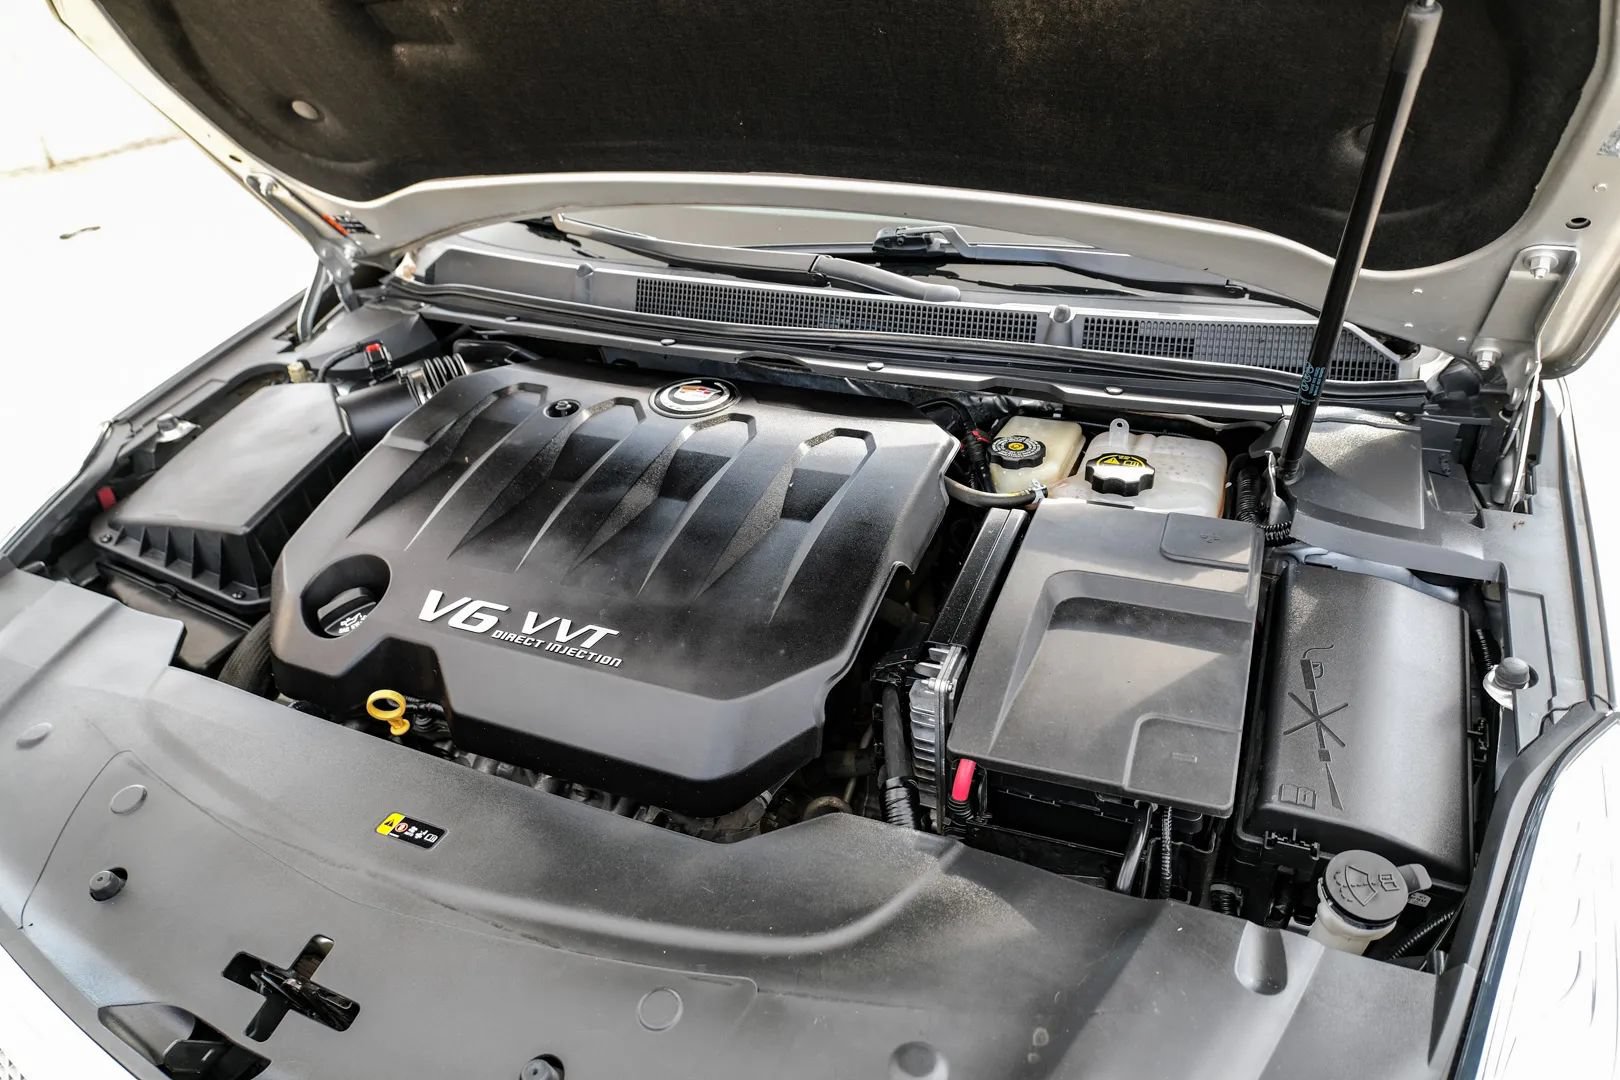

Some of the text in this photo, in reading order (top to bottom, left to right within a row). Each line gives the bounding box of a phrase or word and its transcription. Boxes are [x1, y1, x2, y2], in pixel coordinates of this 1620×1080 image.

[418, 589, 620, 649] V6 VVT
[491, 629, 623, 668] DIRECT INJECTION
